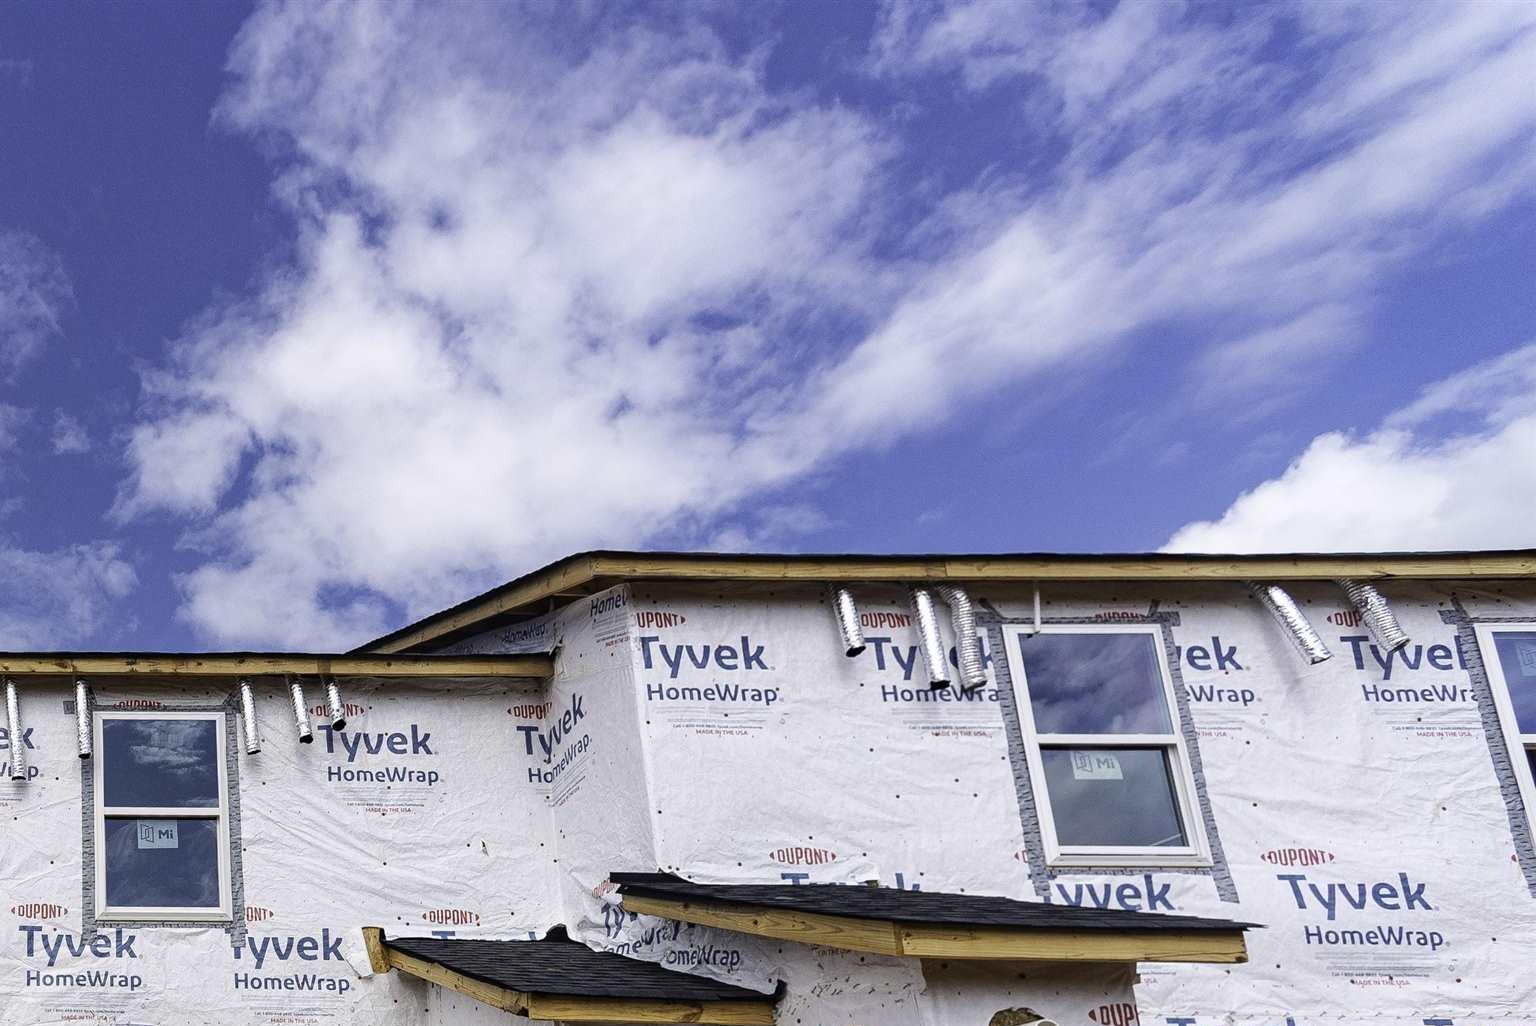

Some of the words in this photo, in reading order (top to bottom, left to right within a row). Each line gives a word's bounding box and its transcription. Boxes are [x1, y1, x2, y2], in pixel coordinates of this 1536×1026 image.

[590, 589, 628, 616] Home
[636, 611, 679, 628] UPONT
[1335, 612, 1362, 628] DUP
[640, 635, 768, 677] Tyvek
[647, 683, 779, 705] HomeWrap
[882, 684, 1000, 703] HomeWra
[316, 705, 359, 718] DUNT
[516, 692, 586, 763] Tyvek
[317, 725, 432, 762] Tyvek
[528, 735, 590, 784] HomeWrap
[1097, 757, 1115, 770] Mi
[327, 766, 439, 786] HomeWrap
[158, 828, 175, 841] Mi
[777, 848, 830, 865] DUPONT
[1268, 849, 1327, 866] DUPONT
[1056, 874, 1176, 911] yvek
[1277, 873, 1434, 920] Tyvek
[18, 903, 62, 918] DUPONT
[245, 907, 269, 922] ONT
[429, 910, 474, 925] DUPONT
[1305, 925, 1444, 951] HomeWrap
[25, 970, 142, 992] HomeWrap
[234, 973, 350, 995] HomeWrap
